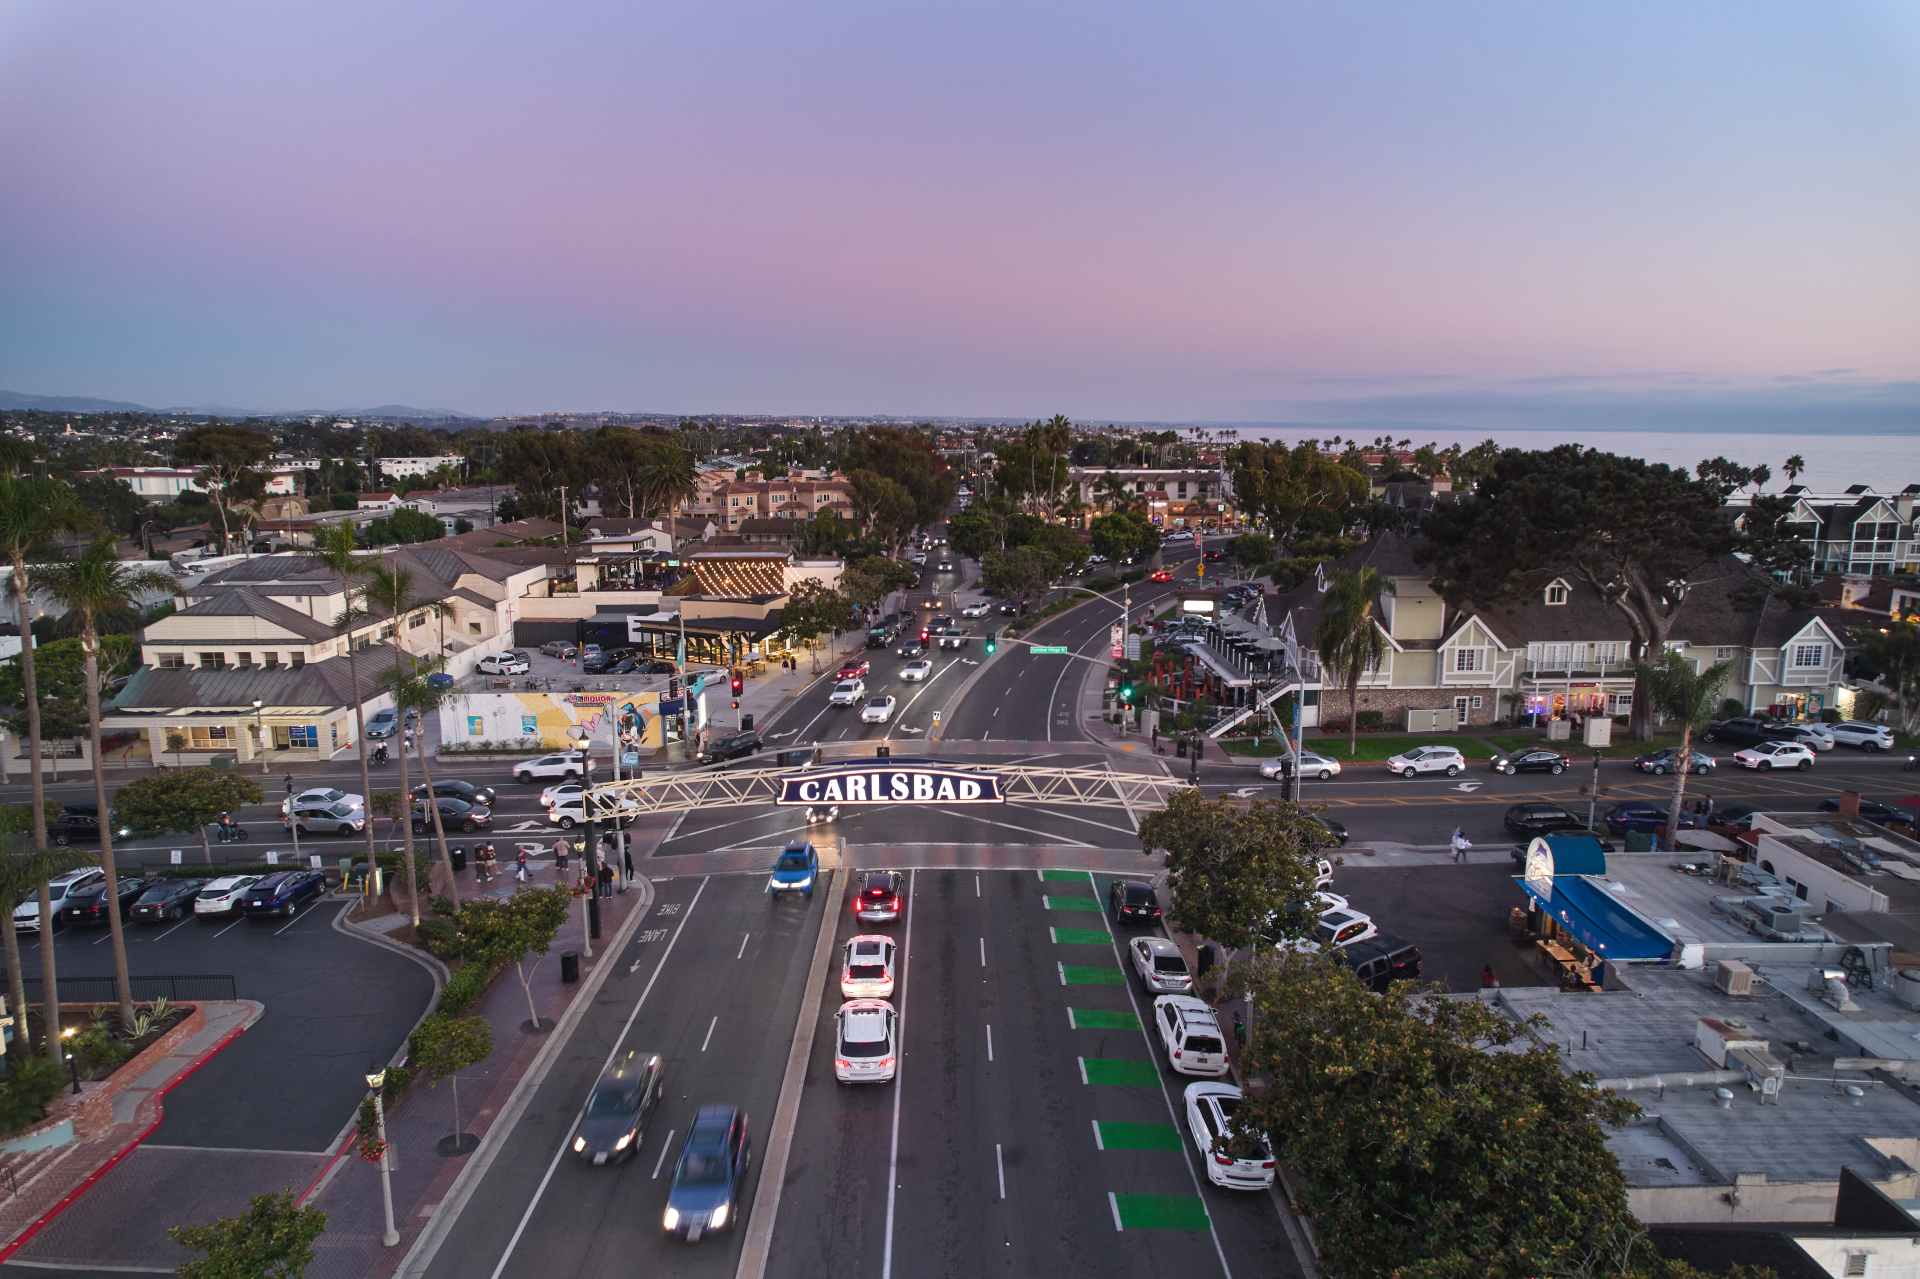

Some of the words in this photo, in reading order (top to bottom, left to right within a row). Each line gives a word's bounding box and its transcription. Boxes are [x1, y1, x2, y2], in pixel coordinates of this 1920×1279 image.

[799, 773, 982, 801] CARLSBAD
[657, 904, 681, 916] BIKE
[638, 929, 668, 943] LANE
